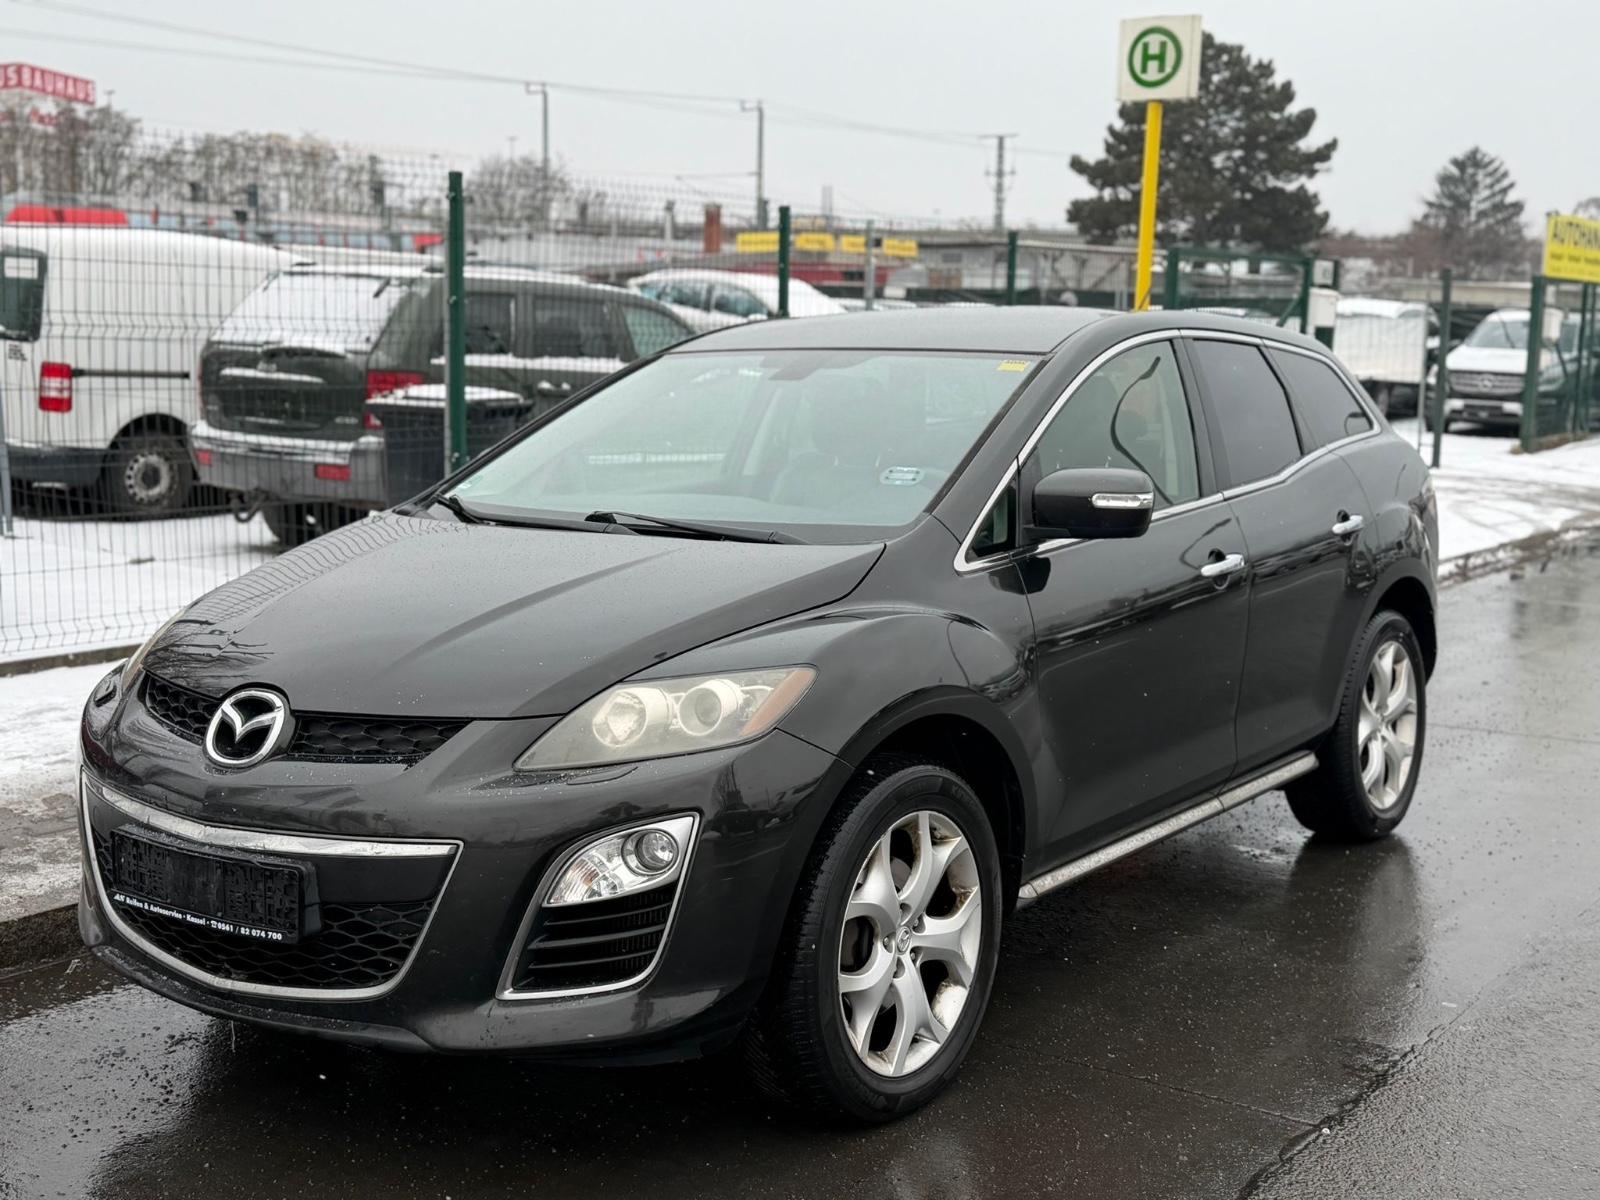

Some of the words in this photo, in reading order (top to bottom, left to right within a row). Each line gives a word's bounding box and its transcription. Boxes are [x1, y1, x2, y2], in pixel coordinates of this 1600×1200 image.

[1140, 40, 1168, 75] H
[20, 64, 95, 103] BAUHAUS
[186, 913, 206, 926] Kassel
[251, 929, 266, 938] 074
[267, 931, 283, 941] 700
